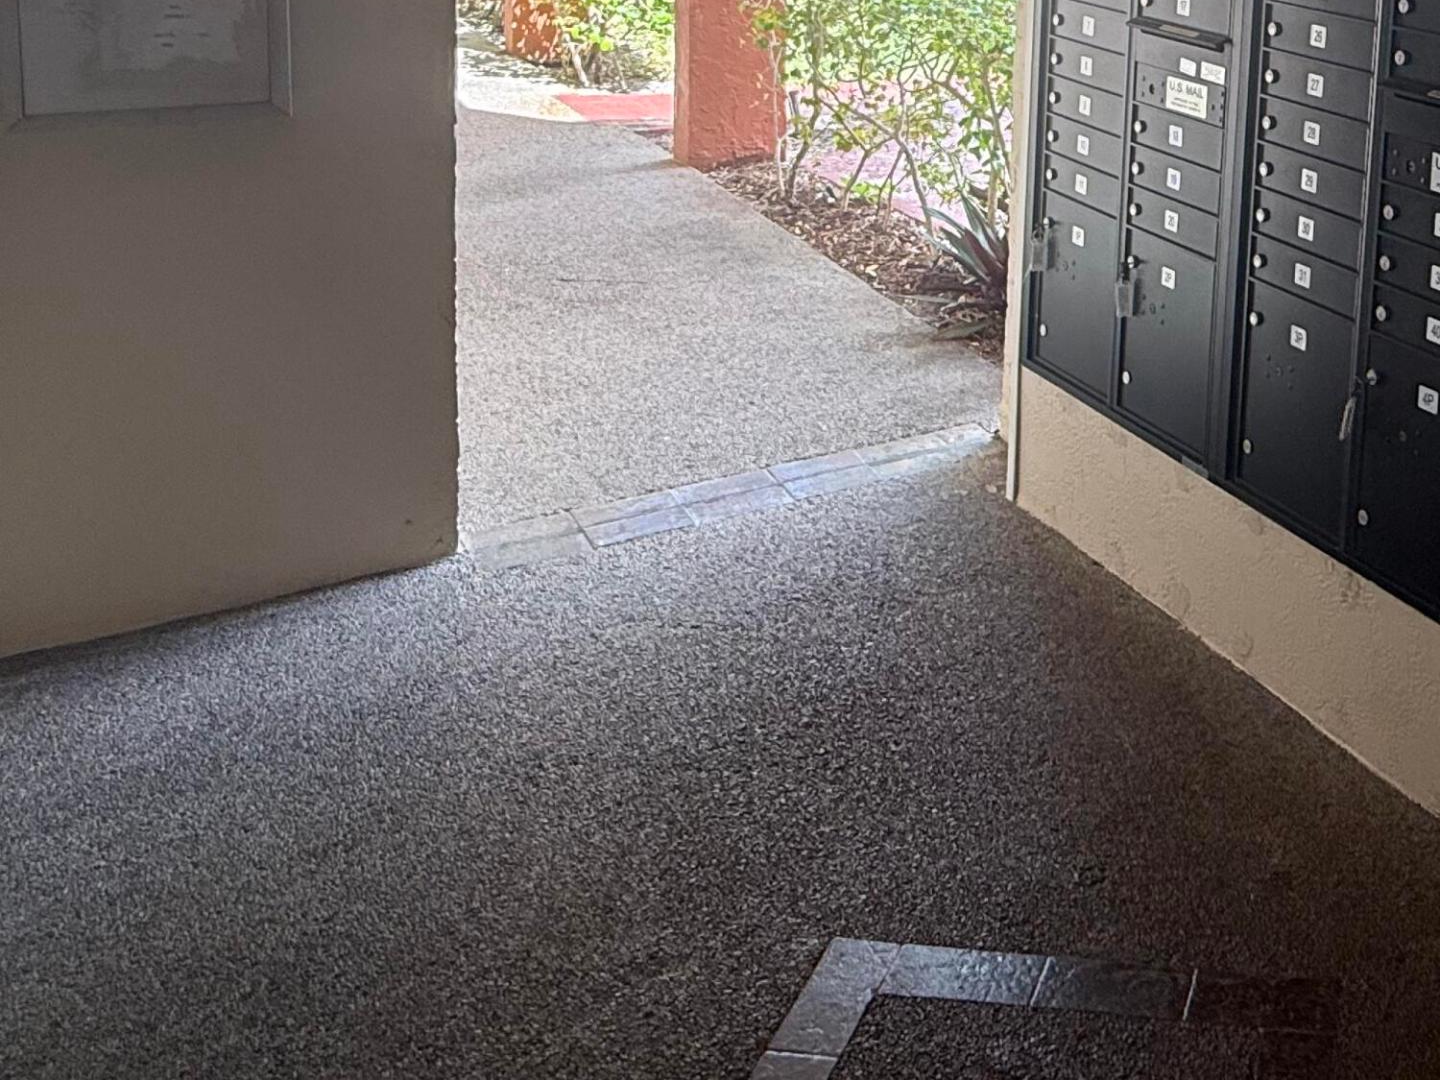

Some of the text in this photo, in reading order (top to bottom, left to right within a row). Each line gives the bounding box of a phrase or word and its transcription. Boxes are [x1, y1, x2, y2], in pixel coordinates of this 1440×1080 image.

[1313, 30, 1323, 43] 26
[1309, 78, 1320, 91] 27
[1186, 84, 1203, 99] MAIL
[1294, 331, 1304, 344] 3P
[1422, 393, 1435, 405] 4P
